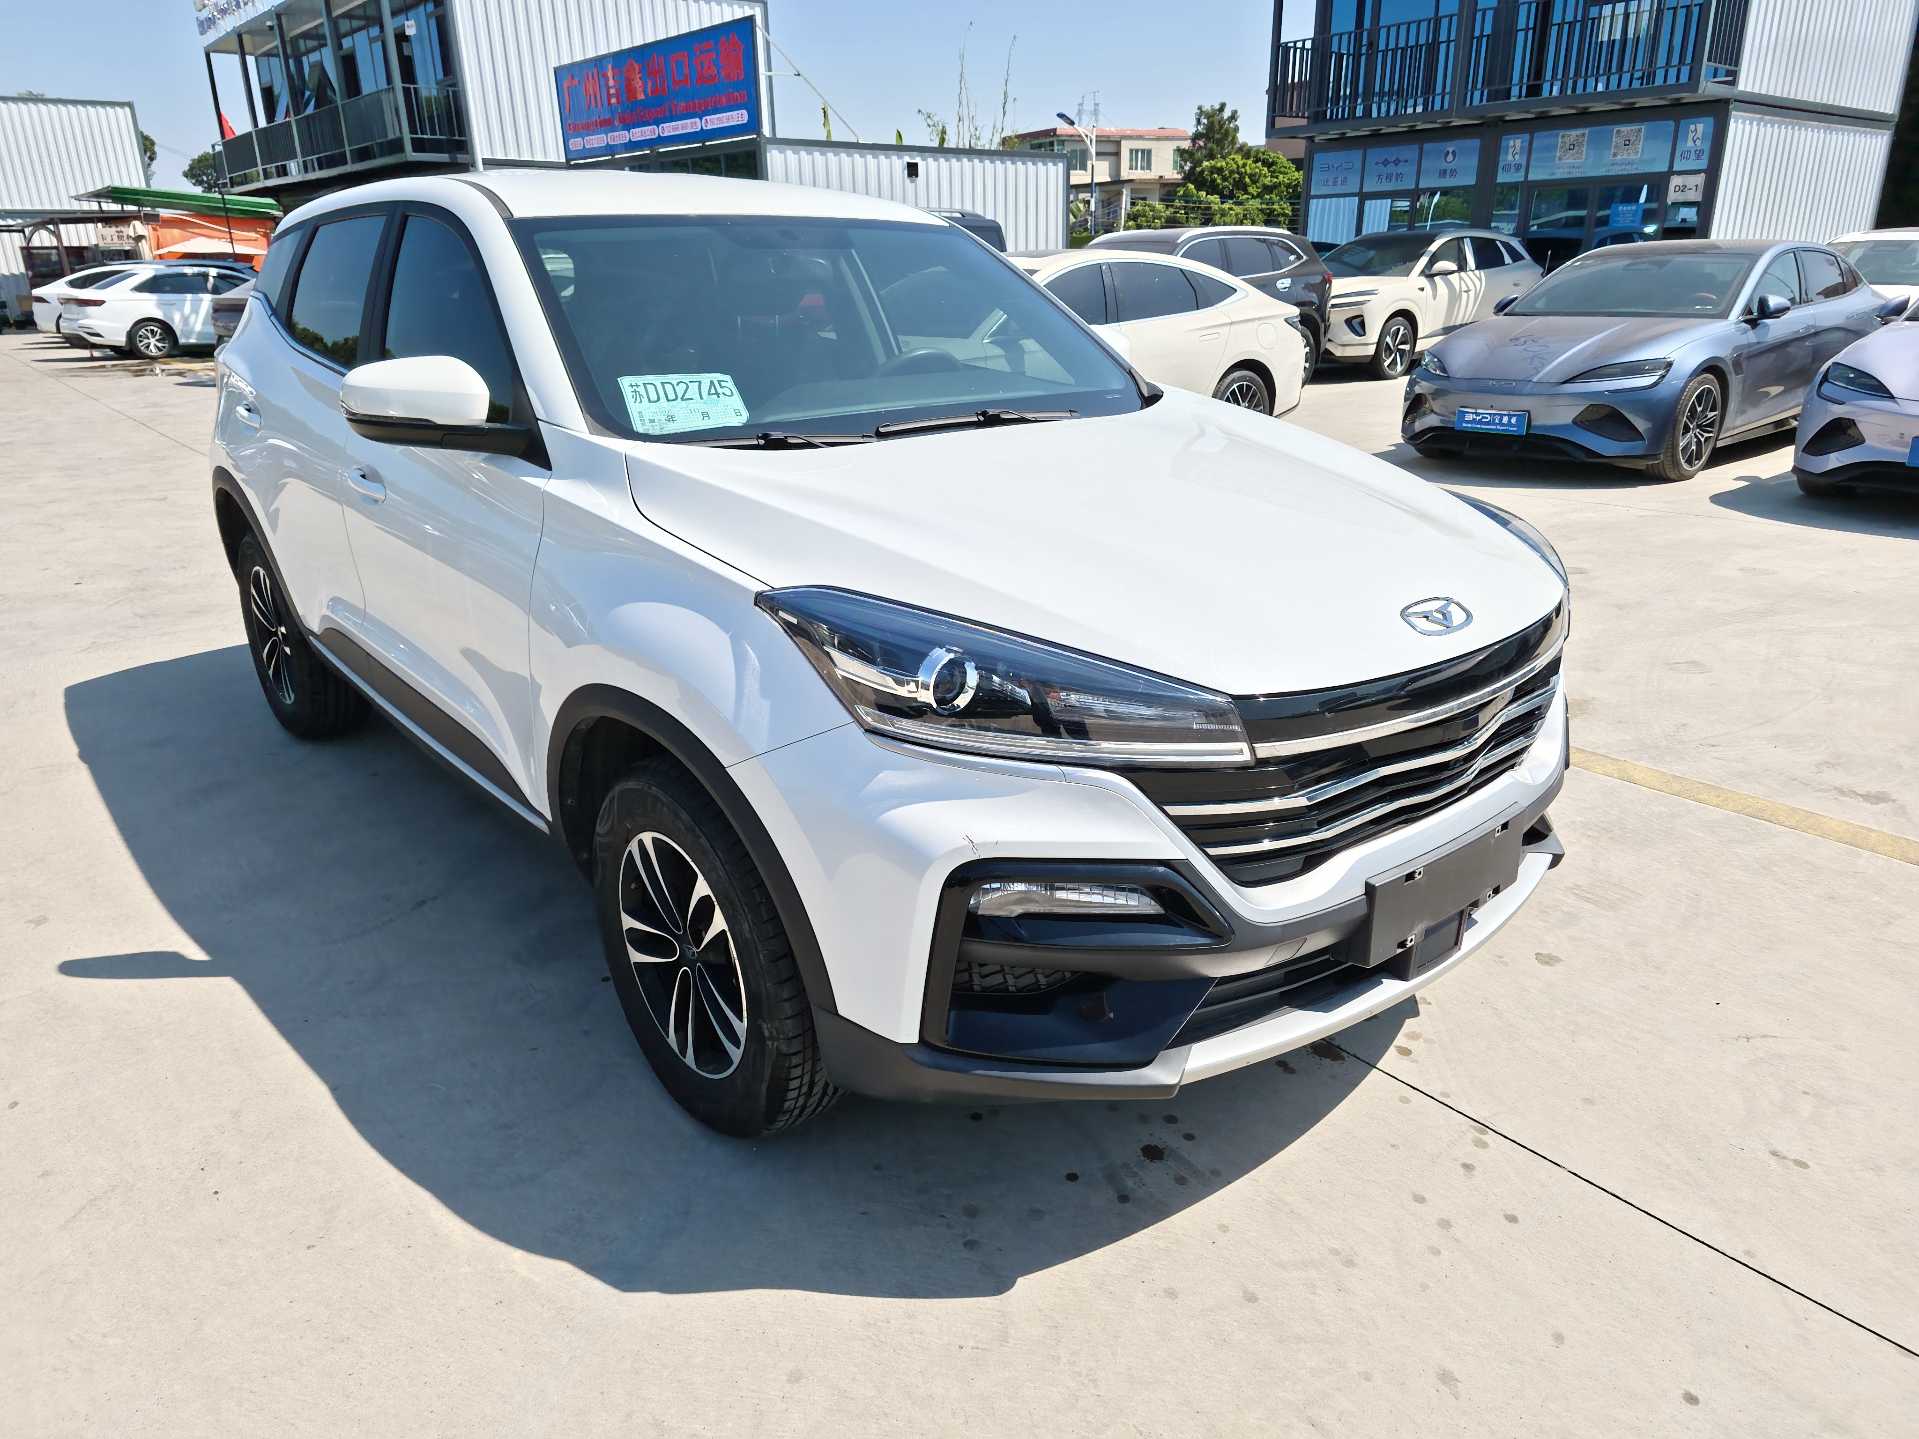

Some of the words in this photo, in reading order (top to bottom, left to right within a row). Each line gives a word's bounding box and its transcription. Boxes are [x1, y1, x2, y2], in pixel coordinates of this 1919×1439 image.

[562, 32, 745, 113] 广州吉鑫出口运输
[1673, 184, 1700, 194] D2-1
